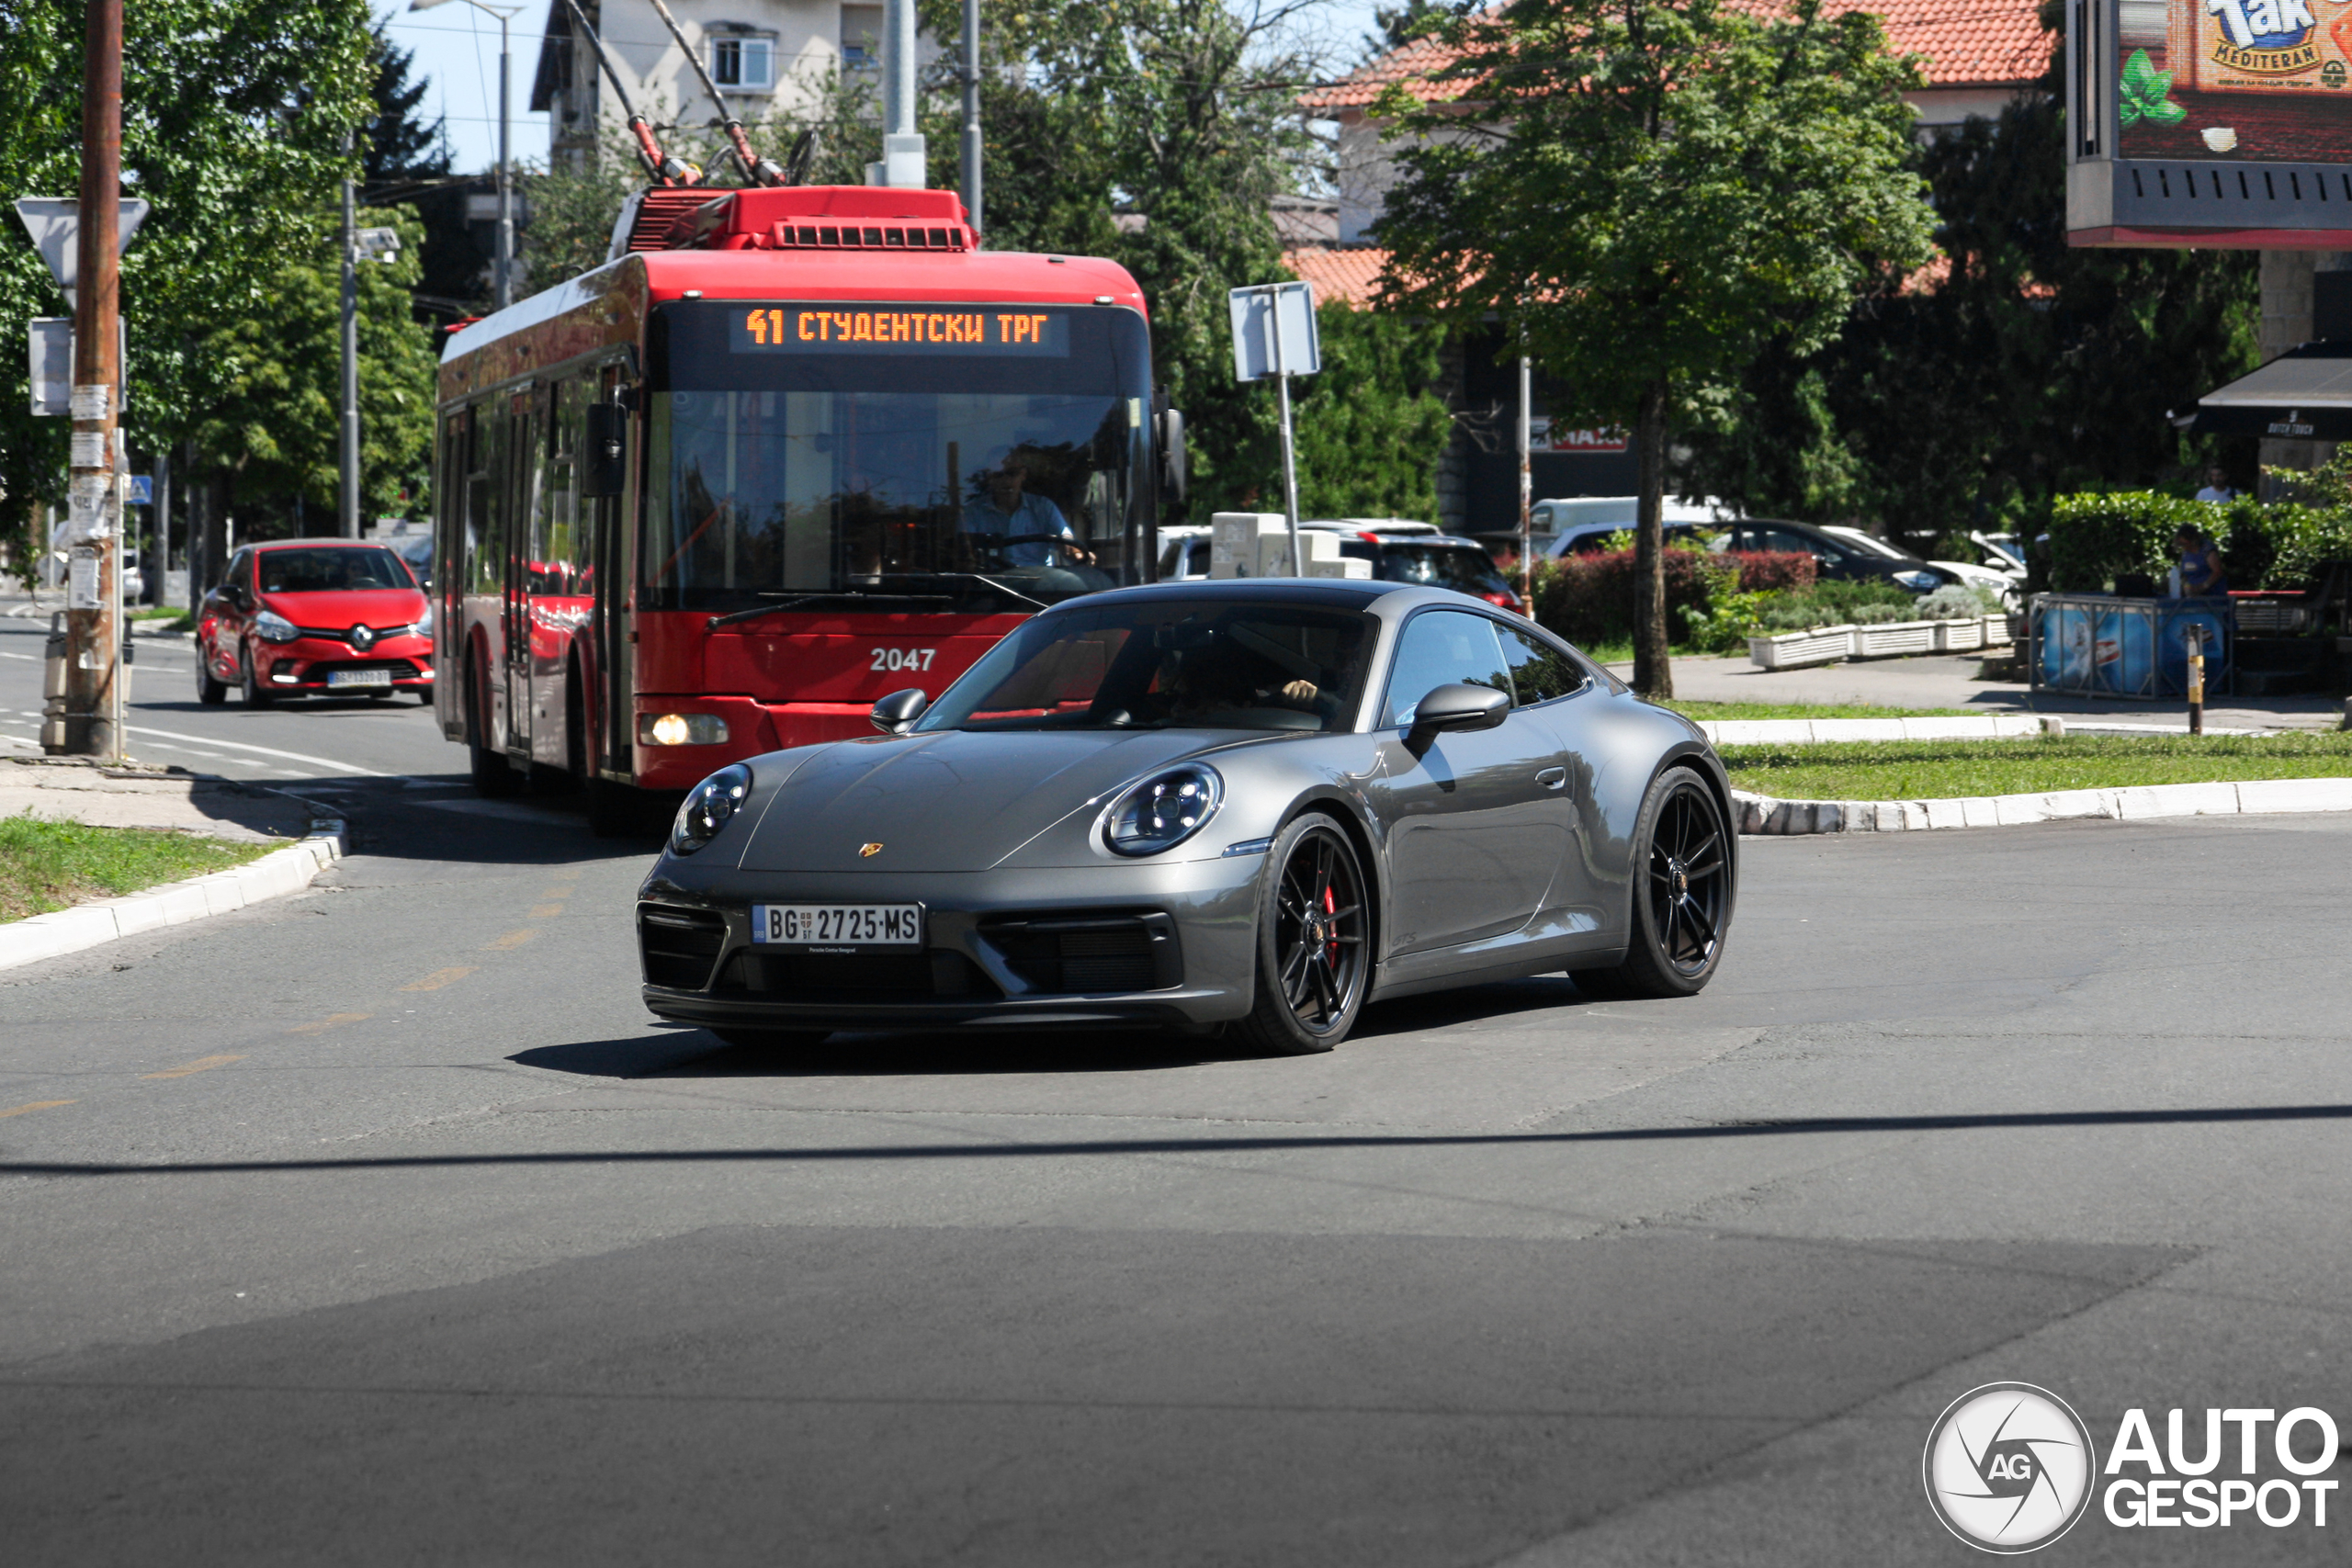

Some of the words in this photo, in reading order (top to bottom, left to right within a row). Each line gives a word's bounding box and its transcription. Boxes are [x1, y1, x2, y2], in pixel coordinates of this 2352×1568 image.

[2216, 44, 2314, 69] MEDITERAN
[747, 310, 783, 344] 41
[798, 312, 984, 343] СТУДЕНТСКИ
[998, 314, 1047, 343] ТРГ
[870, 648, 936, 671] 2047
[770, 909, 797, 939] BG
[1392, 931, 1416, 946] GTS
